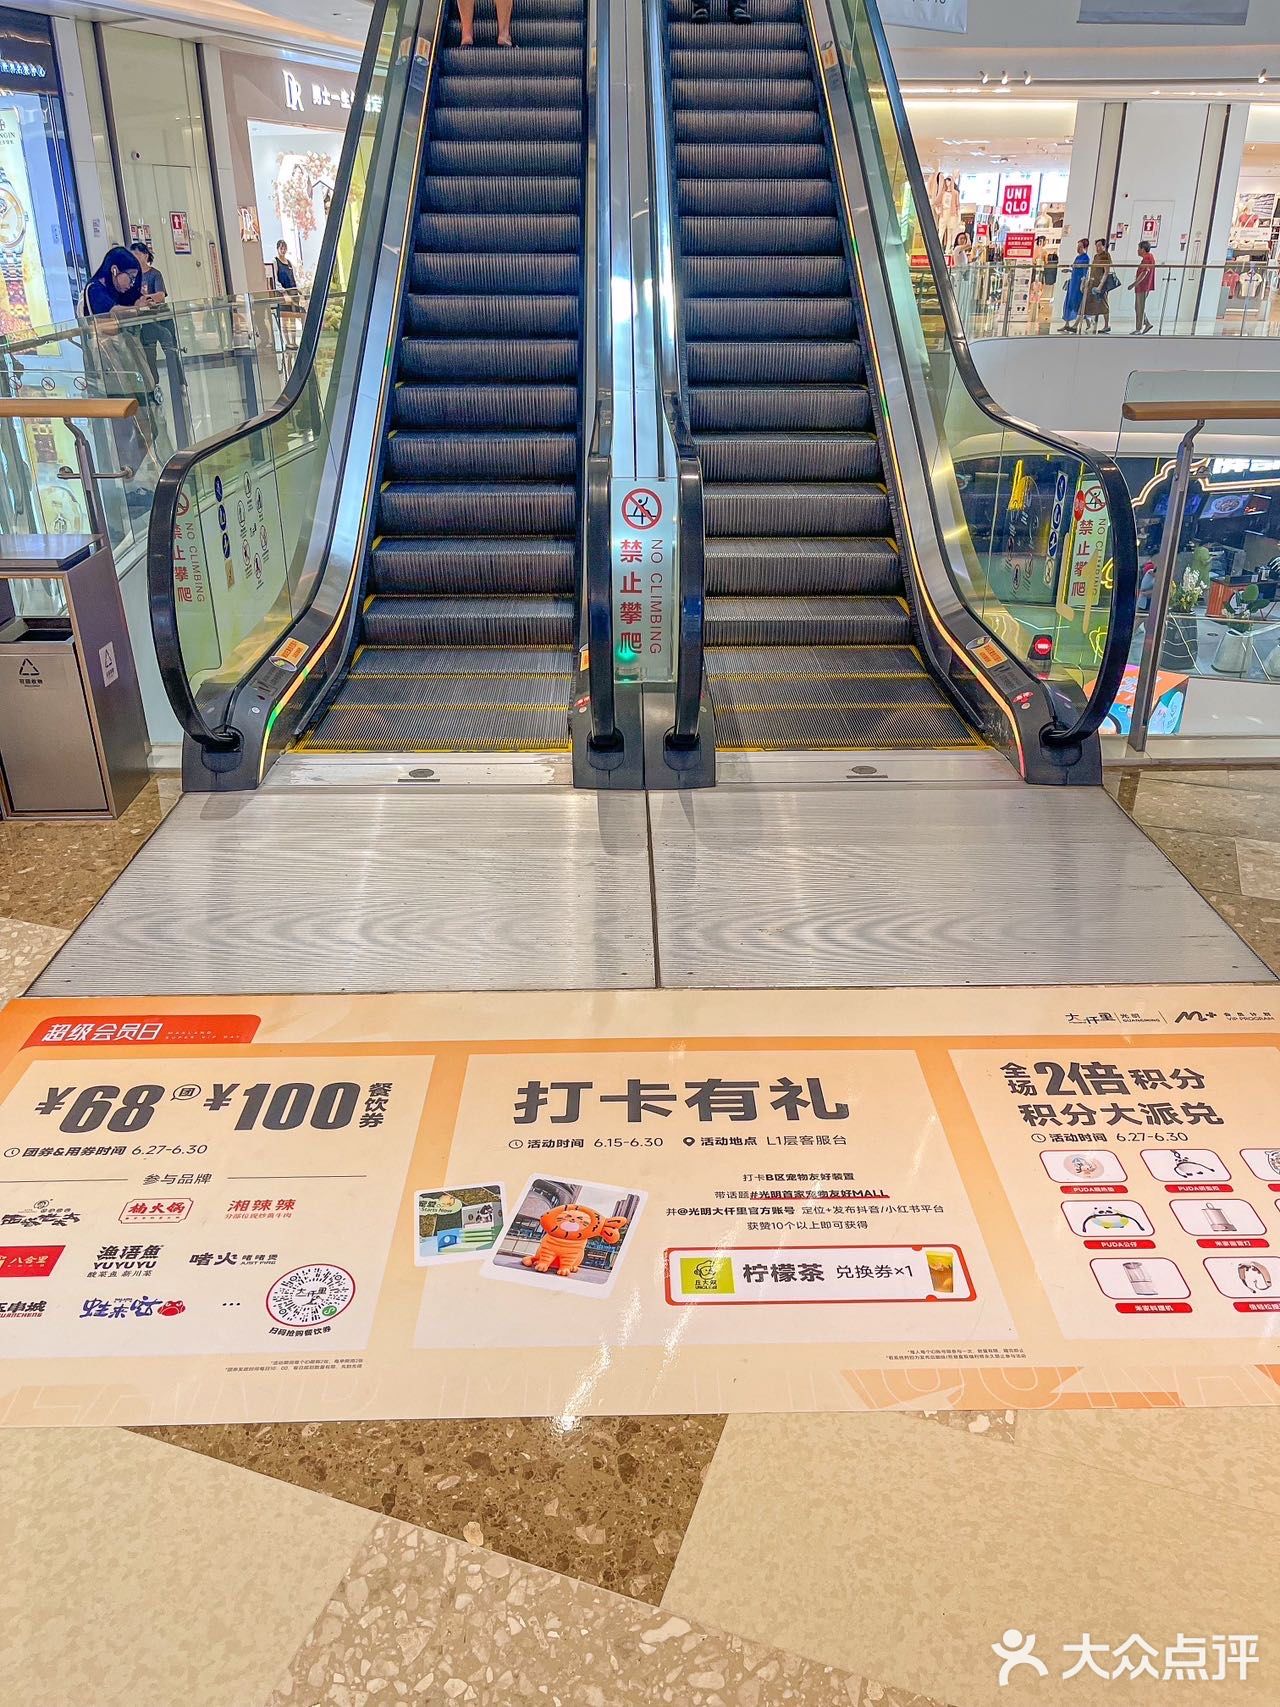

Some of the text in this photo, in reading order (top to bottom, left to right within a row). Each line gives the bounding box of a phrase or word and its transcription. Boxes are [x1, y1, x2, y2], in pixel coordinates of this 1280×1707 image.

[283, 69, 305, 111] DR
[1006, 187, 1027, 200] UNI
[1004, 201, 1028, 212] QLO
[1097, 518, 1106, 535] NO
[185, 522, 206, 603] NO CLIMBING
[619, 539, 643, 654] 禁止攀爬
[649, 539, 663, 654] NO CLIMBING
[42, 1023, 164, 1042] 超级会员日
[1000, 1062, 1038, 1097] 全场
[1033, 1061, 1206, 1096] 2倍 积分
[203, 1082, 360, 1131] ¥100
[358, 1082, 393, 1129] 餐饮券
[513, 1077, 850, 1125] 打卡有礼
[1018, 1101, 1225, 1127] 积分大派兑
[527, 1137, 664, 1149] 活动时间 6.15-6.30
[700, 1135, 847, 1147] 活动地点 L1层客服台
[1049, 1132, 1189, 1143] 活动时间 6.27-6.30
[22, 1144, 208, 1157] 团券&用券时间 6.27-6.30
[142, 1173, 213, 1185] 参与品牌
[742, 1173, 855, 1182] 打卡B区宠物友好装置
[714, 1189, 889, 1199] 带话题#光明首家宠物友好MALL
[227, 1199, 296, 1212] 湘辣辣
[666, 1205, 945, 1216] 并@光明大仟里官方账号 定位+发布抖音/小红书平台
[747, 1221, 868, 1230] 获赞10个以上即可获得
[93, 1261, 157, 1270] YUYUYU
[743, 1263, 825, 1283] 柠檬茶
